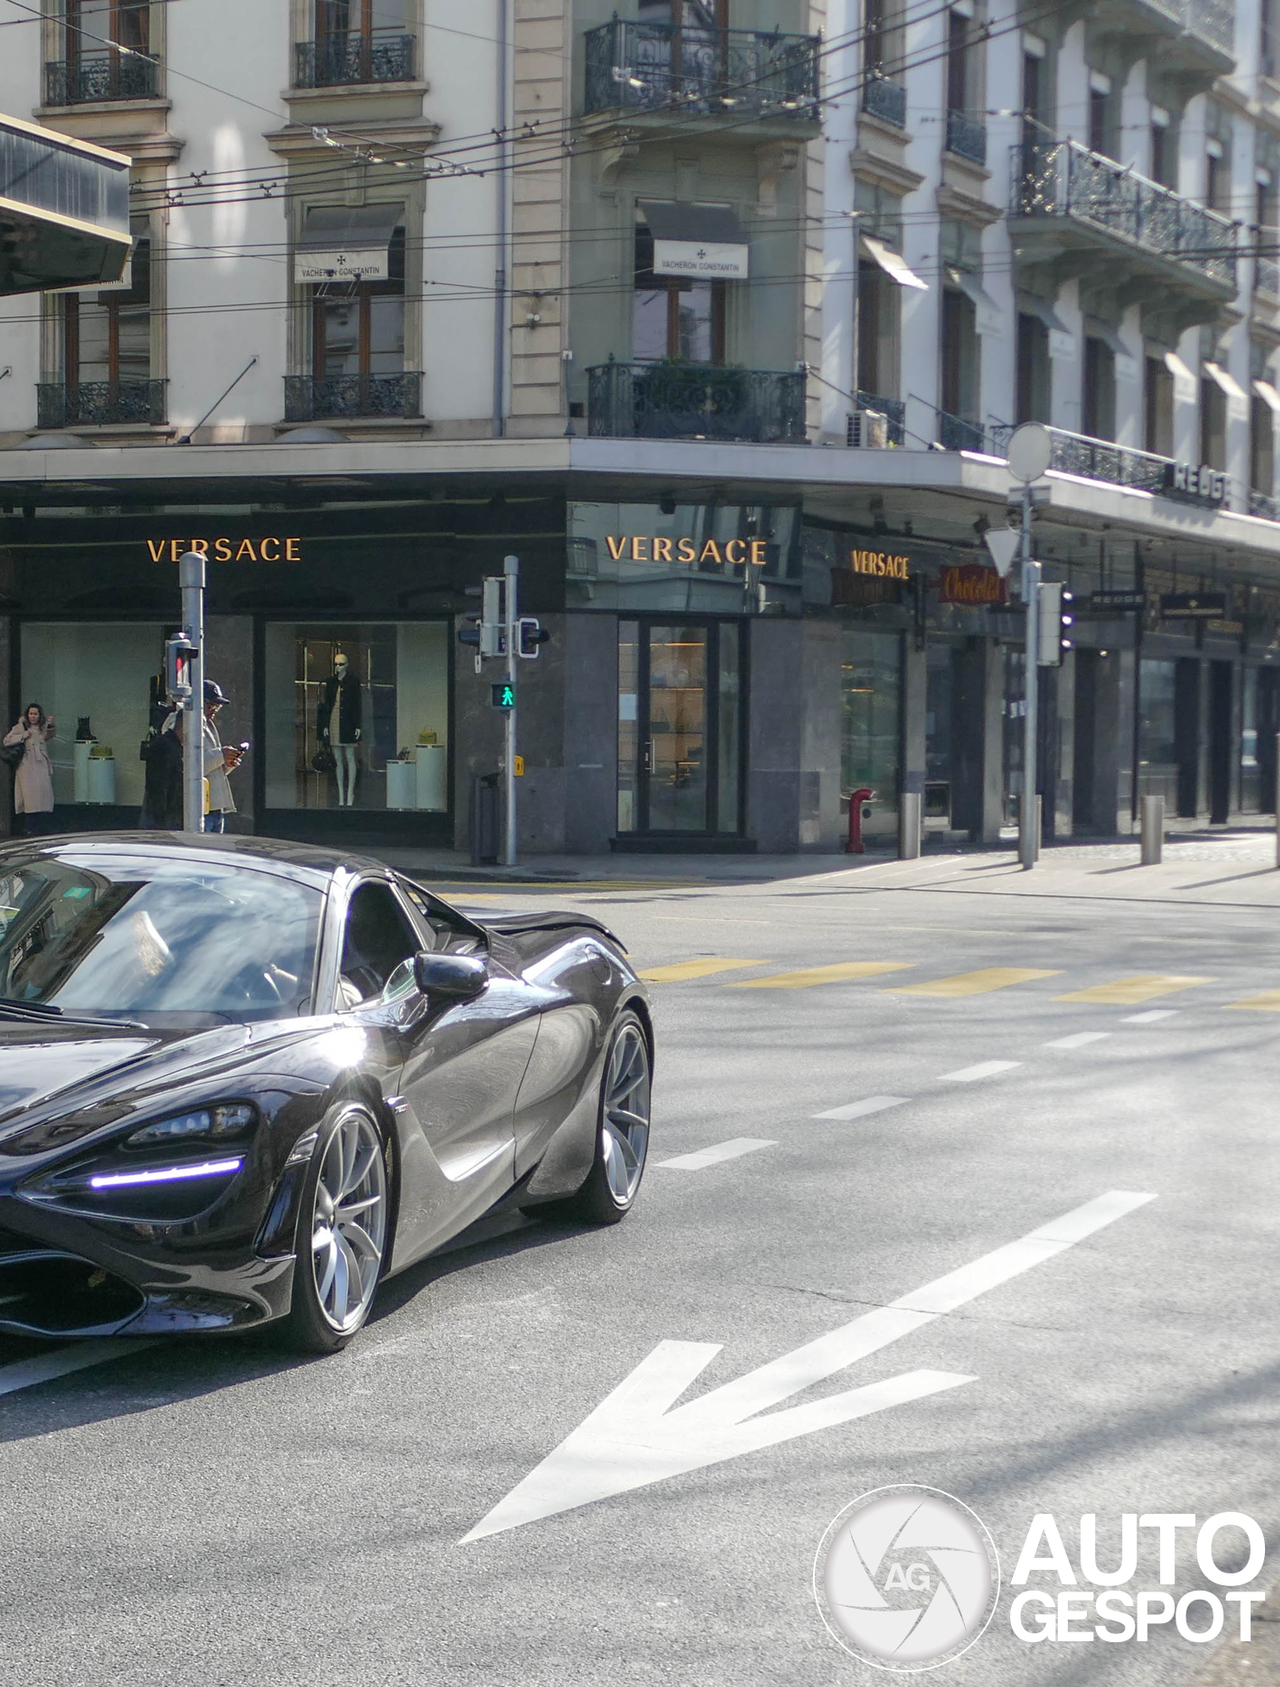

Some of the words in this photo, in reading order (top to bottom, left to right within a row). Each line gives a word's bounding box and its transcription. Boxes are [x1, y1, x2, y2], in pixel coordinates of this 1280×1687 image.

[302, 269, 336, 277] VACHER
[339, 267, 380, 276] CONSTANTIN
[662, 261, 697, 270] VACHERON
[699, 262, 739, 271] CONSTANTIN
[147, 537, 301, 562] VERSACE
[606, 535, 767, 565] VERSACE
[853, 550, 910, 580] VERSACE
